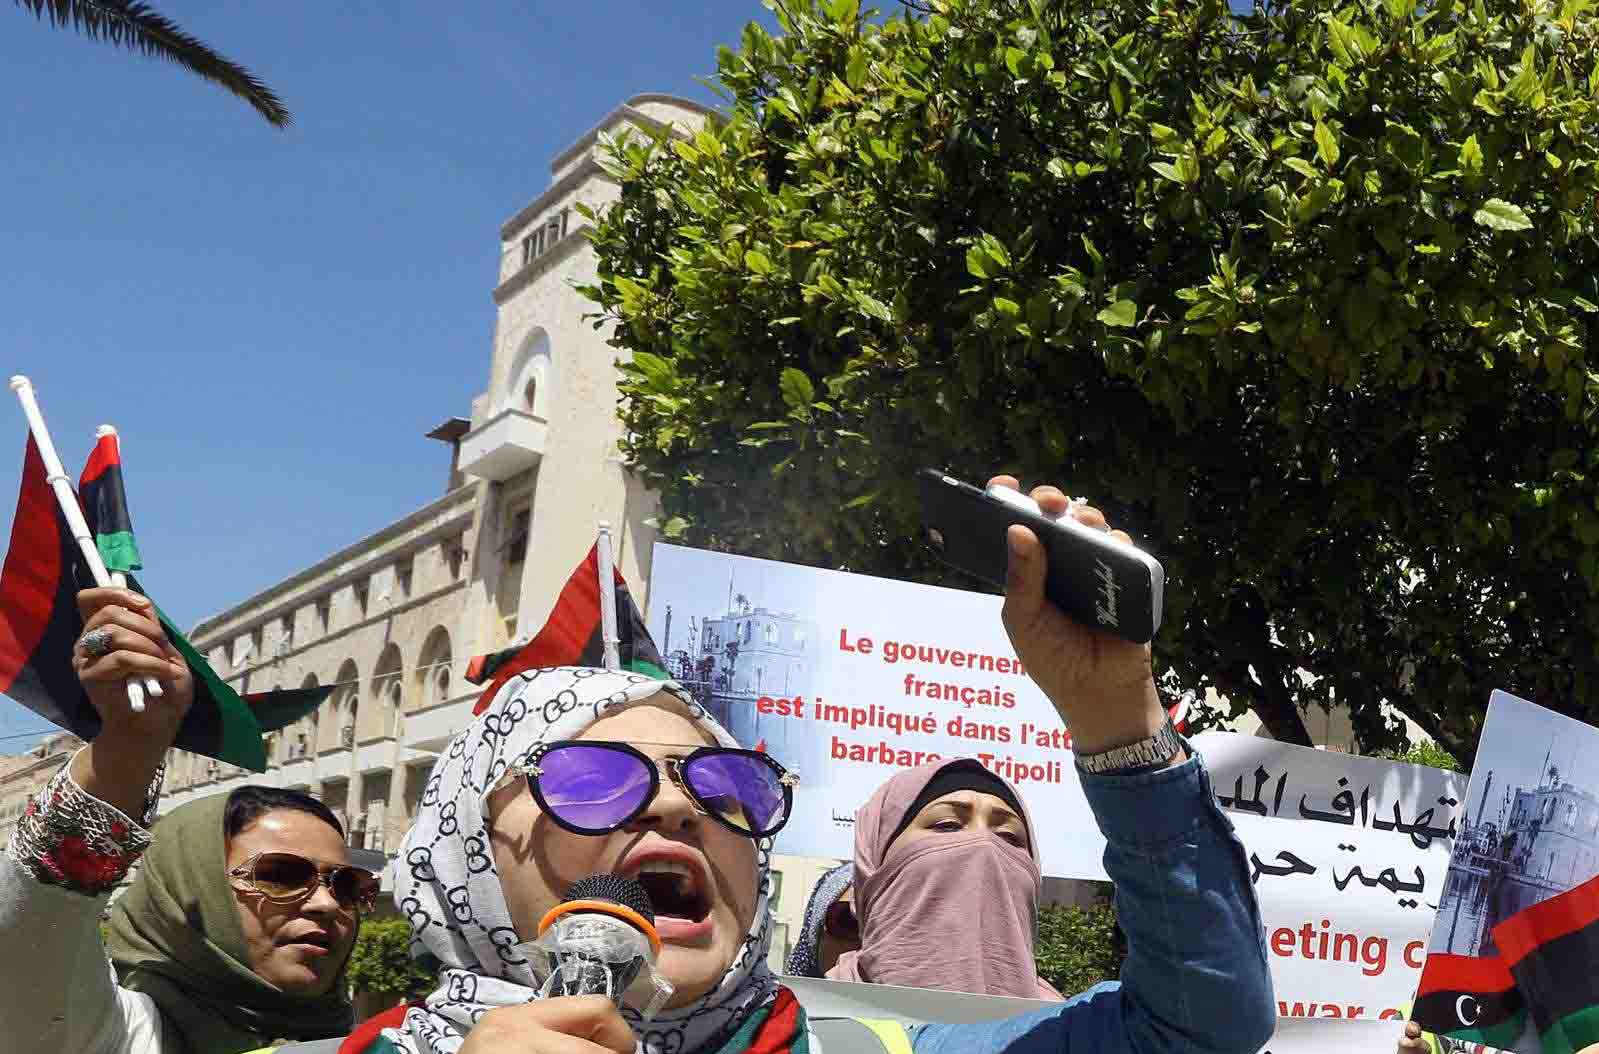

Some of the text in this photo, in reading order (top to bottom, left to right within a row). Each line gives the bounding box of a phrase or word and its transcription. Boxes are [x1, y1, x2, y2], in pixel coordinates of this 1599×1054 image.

[838, 628, 874, 654] Le
[903, 673, 1017, 710] français
[756, 694, 805, 719] est
[814, 698, 938, 739] impliqué
[945, 714, 1012, 744] dans
[1332, 842, 1437, 910] يمة
[1269, 919, 1389, 977] eting
